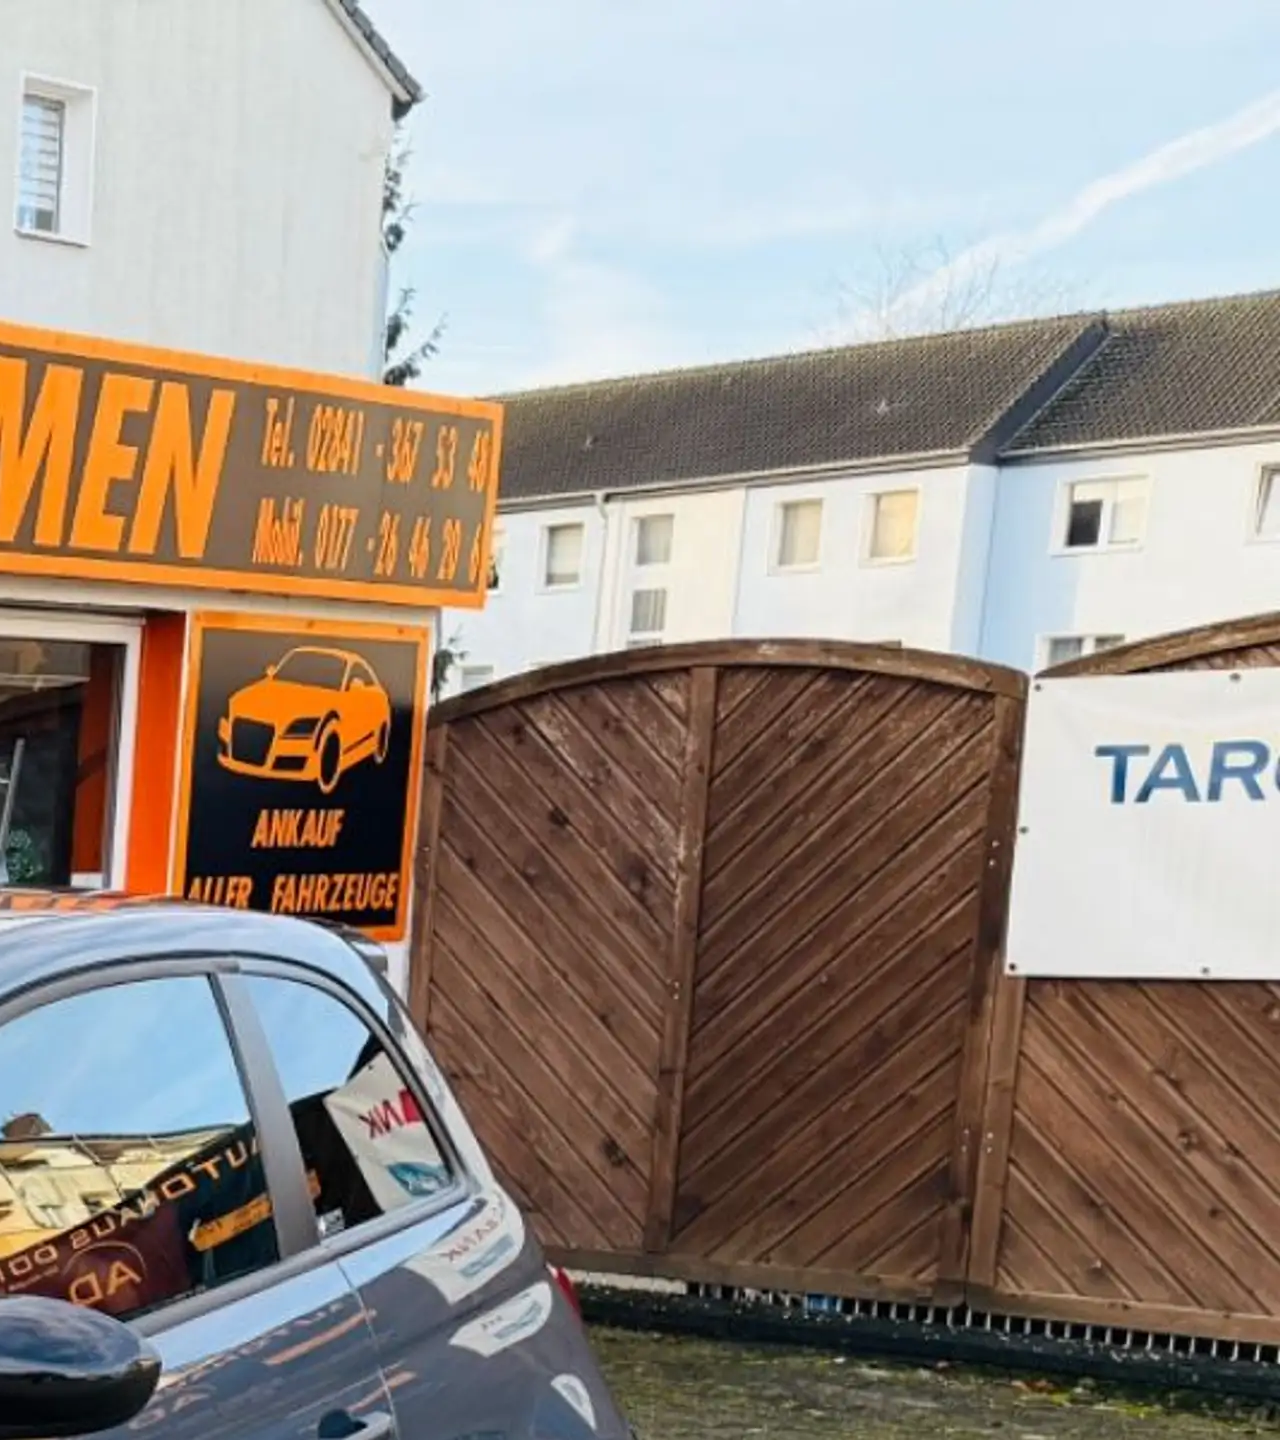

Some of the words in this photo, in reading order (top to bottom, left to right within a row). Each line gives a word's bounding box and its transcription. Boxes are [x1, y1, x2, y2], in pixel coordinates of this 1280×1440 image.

[262, 396, 294, 468] Tel.
[306, 403, 364, 475] 02841
[387, 418, 424, 482] 367
[432, 425, 459, 490] 53
[252, 497, 304, 566] Mobil.
[314, 504, 359, 571] 0177
[1094, 740, 1280, 804] TAR
[251, 808, 344, 848] ANKAUF
[272, 873, 399, 913] FAHRZEUGE
